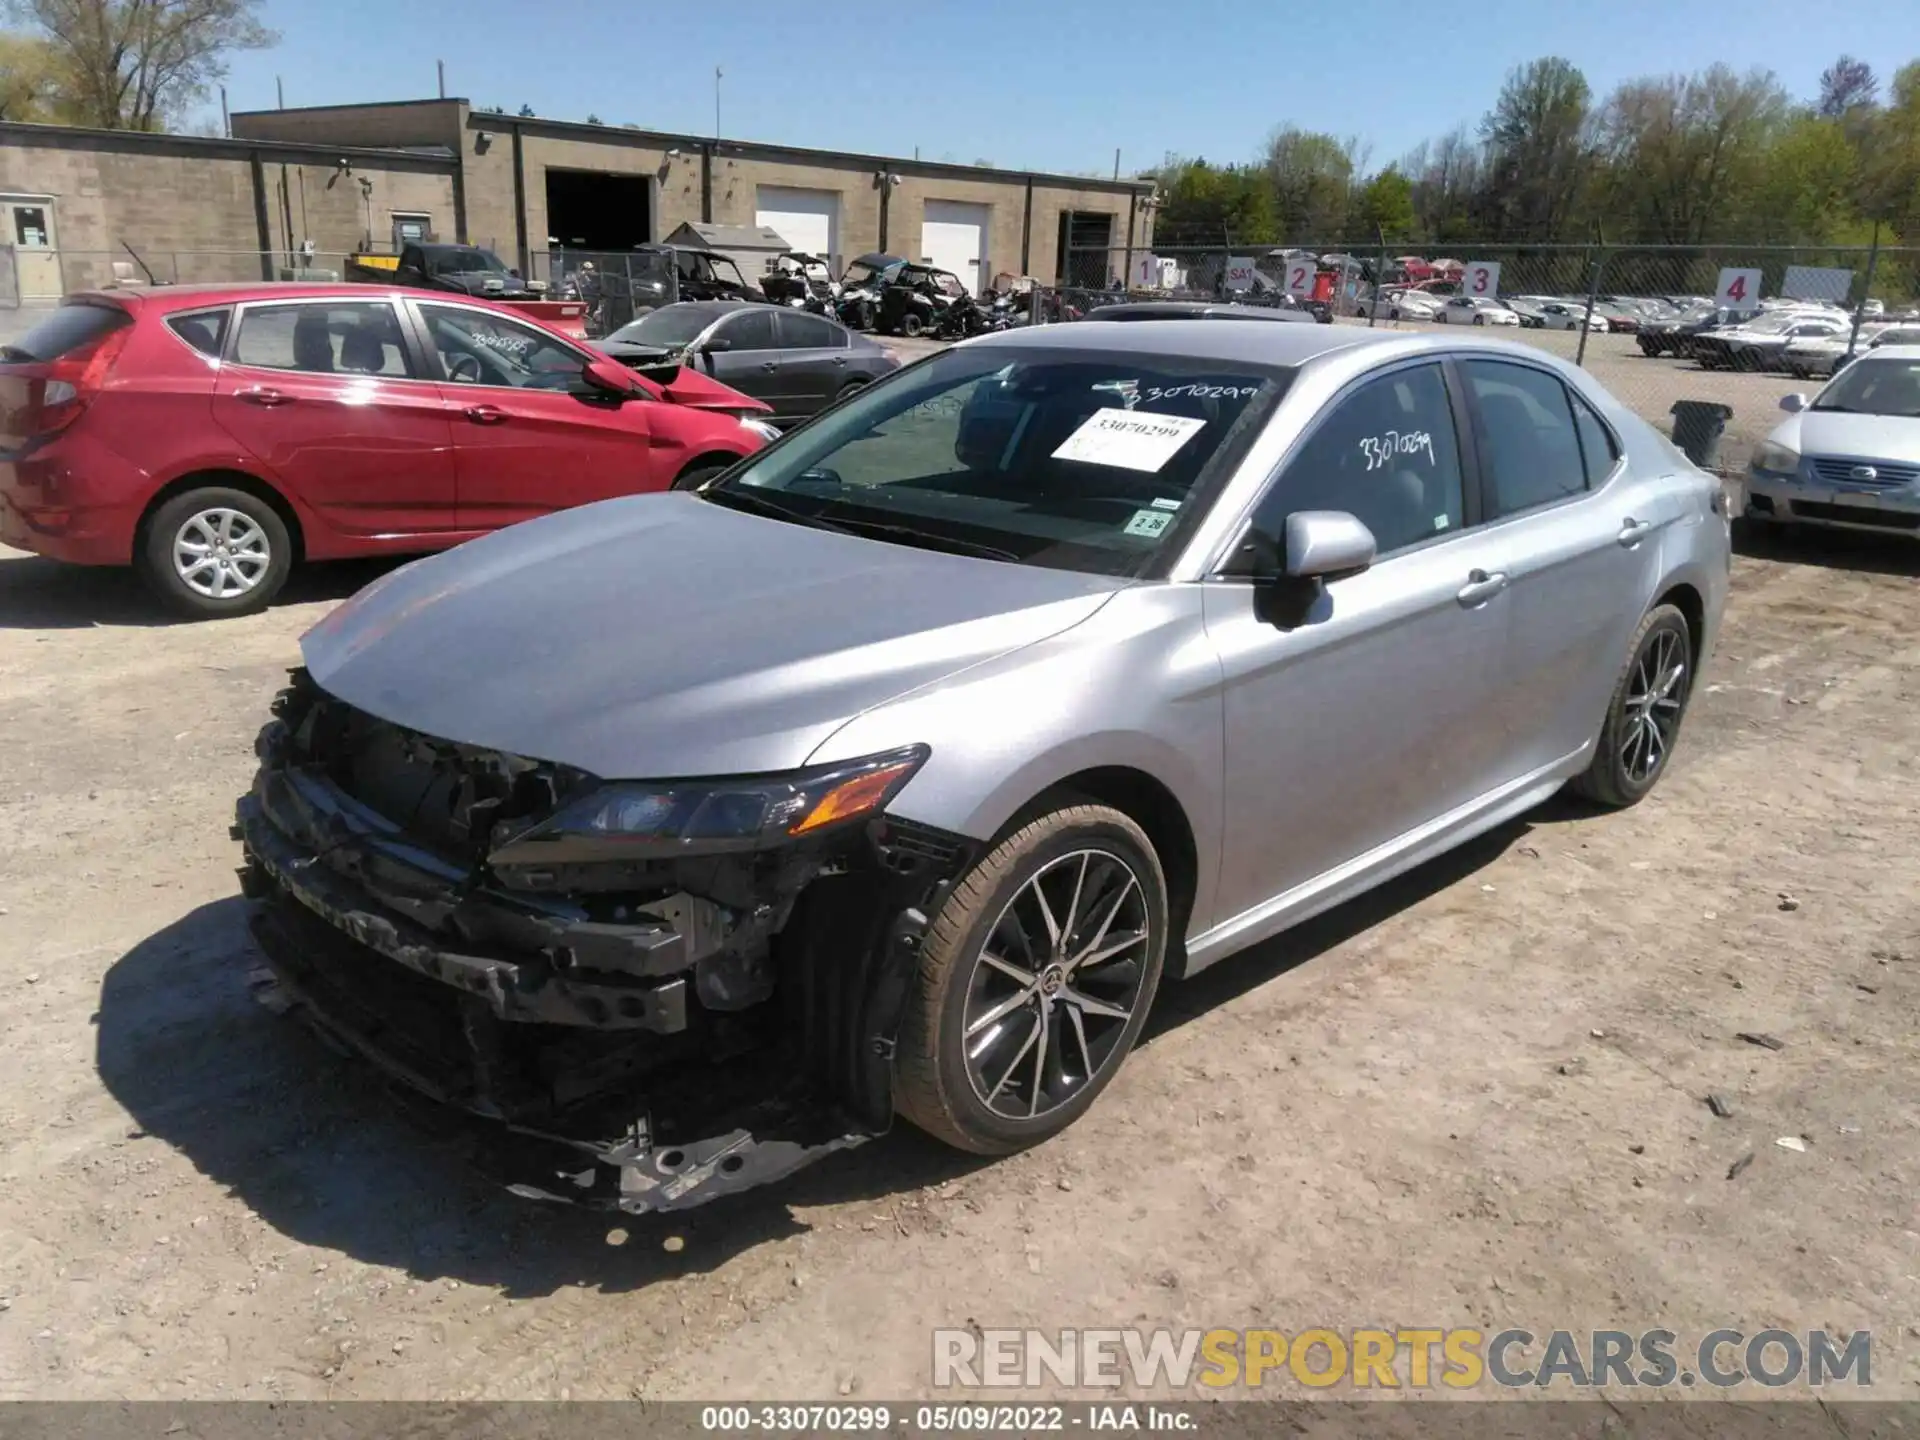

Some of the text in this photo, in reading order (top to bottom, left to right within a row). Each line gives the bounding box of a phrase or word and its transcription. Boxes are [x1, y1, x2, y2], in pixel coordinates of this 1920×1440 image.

[1141, 261, 1148, 280] 1
[1291, 268, 1306, 289] 2
[1472, 268, 1489, 292] 3
[1727, 276, 1746, 302] 4
[1095, 419, 1180, 436] 33070299
